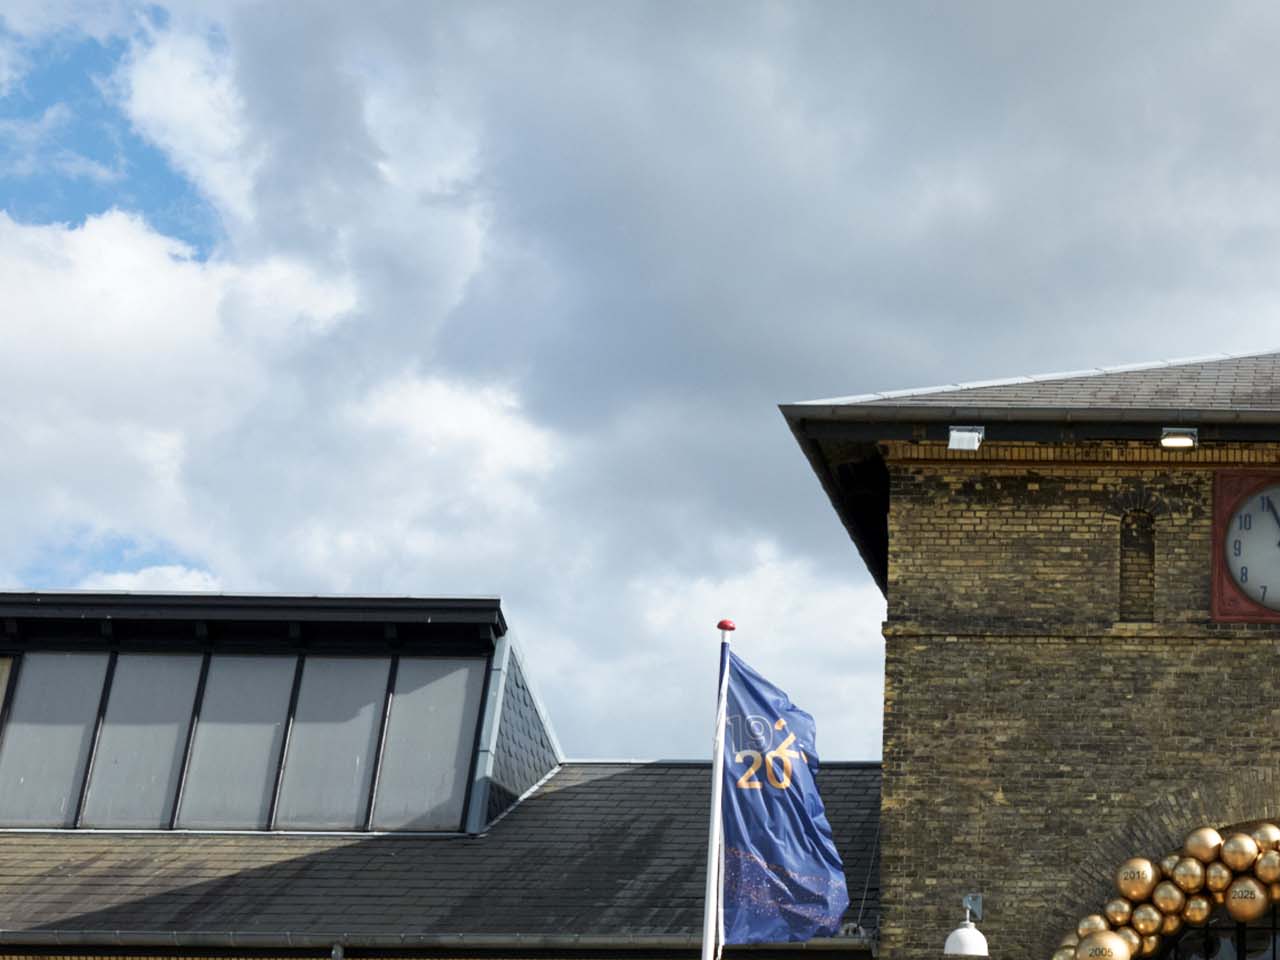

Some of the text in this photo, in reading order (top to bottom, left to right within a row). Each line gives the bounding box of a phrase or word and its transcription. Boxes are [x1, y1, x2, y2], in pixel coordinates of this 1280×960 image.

[1239, 514, 1252, 531] 10
[1233, 540, 1242, 557] 9
[1240, 566, 1249, 583] 8
[1259, 585, 1268, 602] 7
[735, 750, 793, 790] 20
[1231, 889, 1256, 901] 2025
[1088, 947, 1114, 958] 2005
